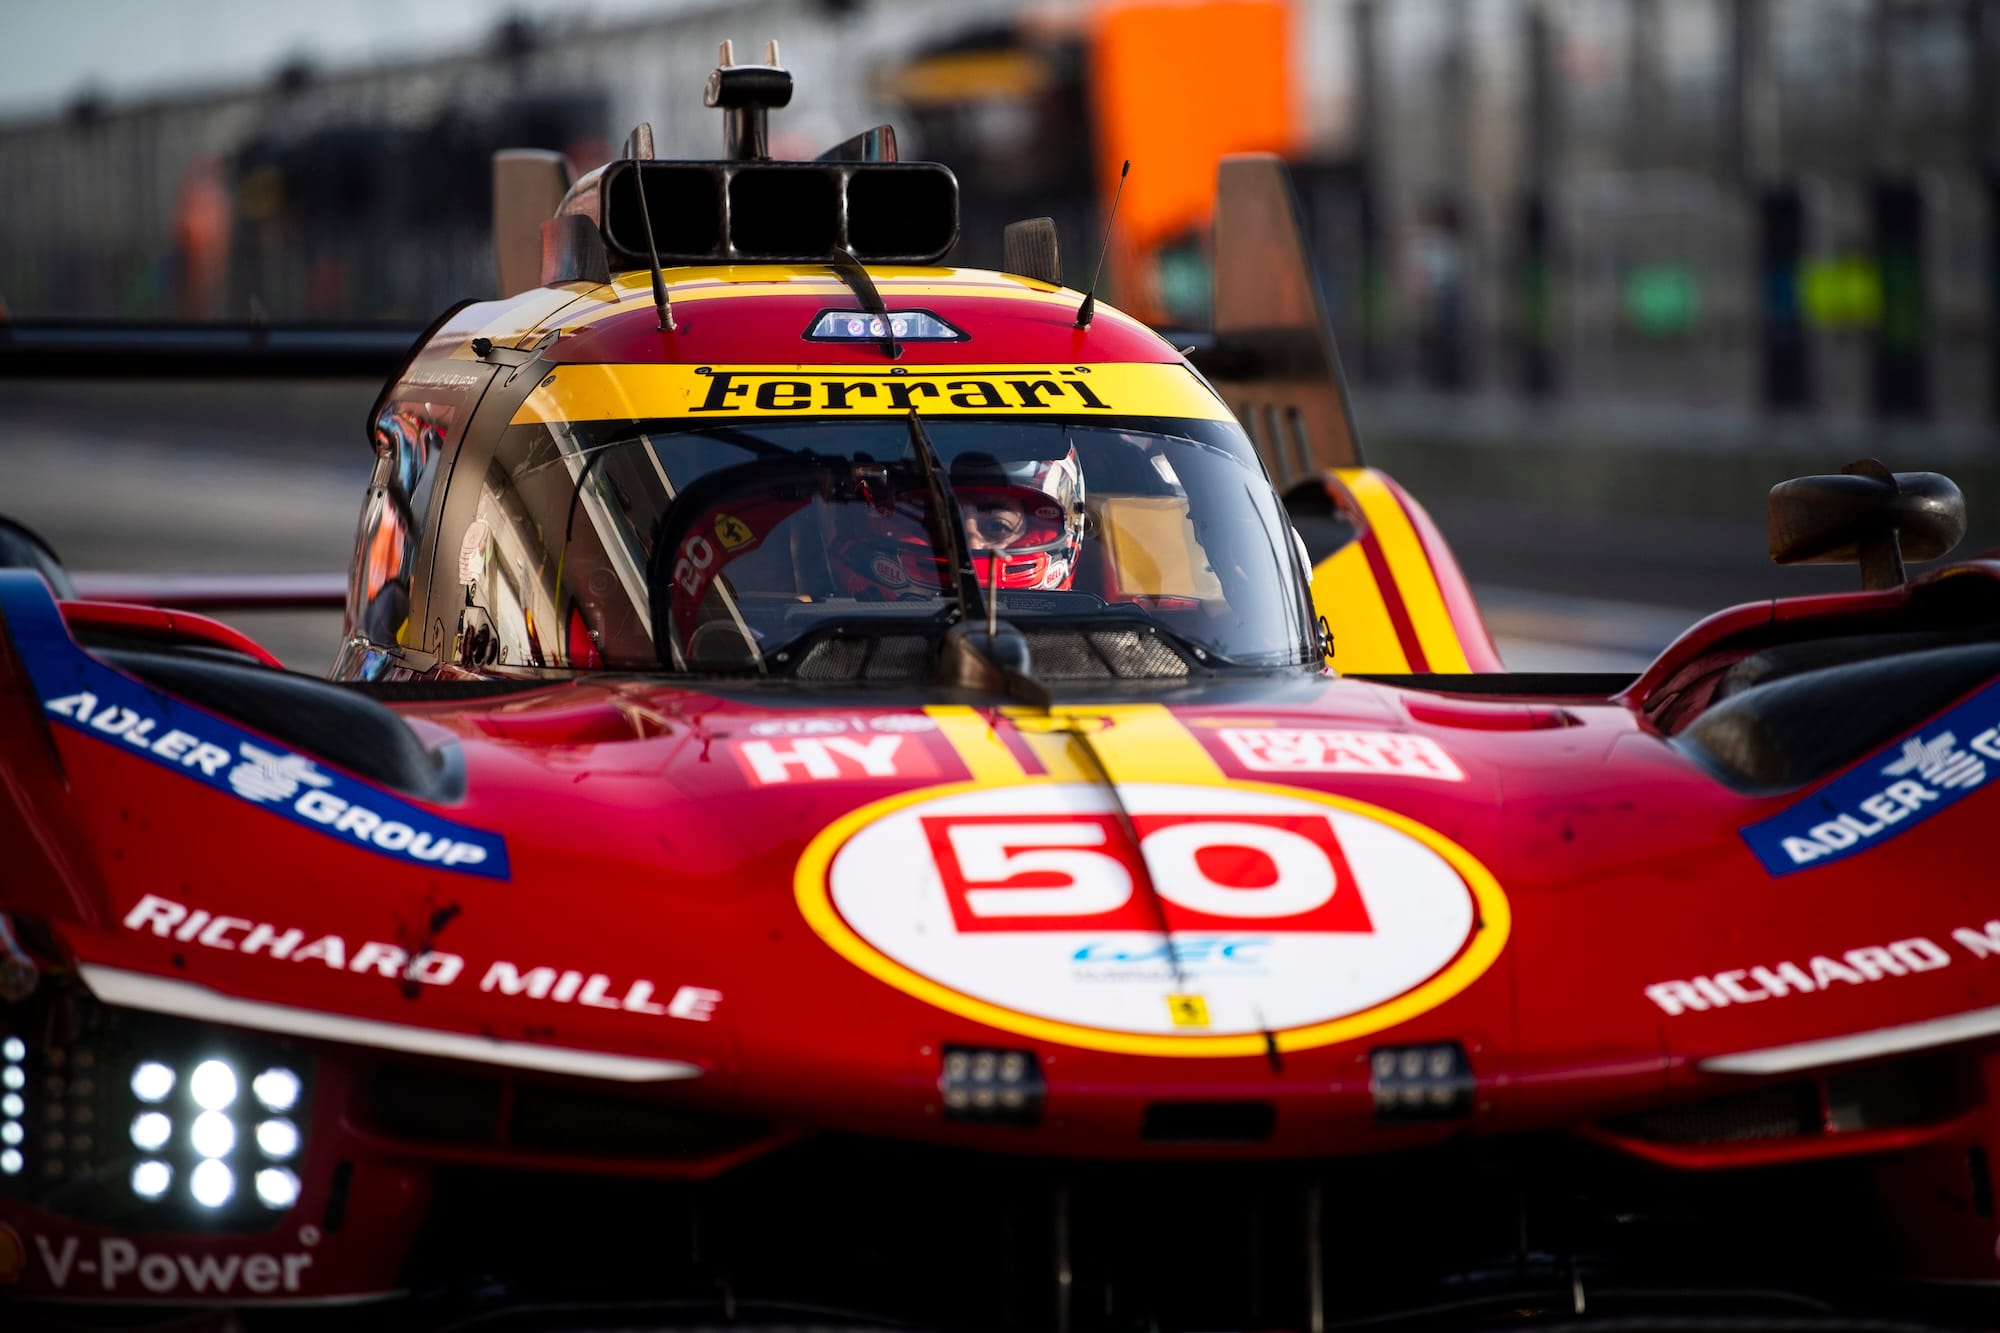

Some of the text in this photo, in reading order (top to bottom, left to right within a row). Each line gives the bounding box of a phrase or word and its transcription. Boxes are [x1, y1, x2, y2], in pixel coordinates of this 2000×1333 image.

[689, 371, 1112, 413] Ferrari
[1046, 565, 1062, 584] BELL
[45, 691, 487, 866] ADLER GROUP
[740, 734, 903, 784] HY
[1781, 779, 1939, 864] ADLER
[946, 821, 1338, 919] 50
[123, 893, 723, 1022] RICHARD MILLE
[1645, 937, 1951, 1016] RICHARD
[36, 1233, 313, 1293] V-Power
